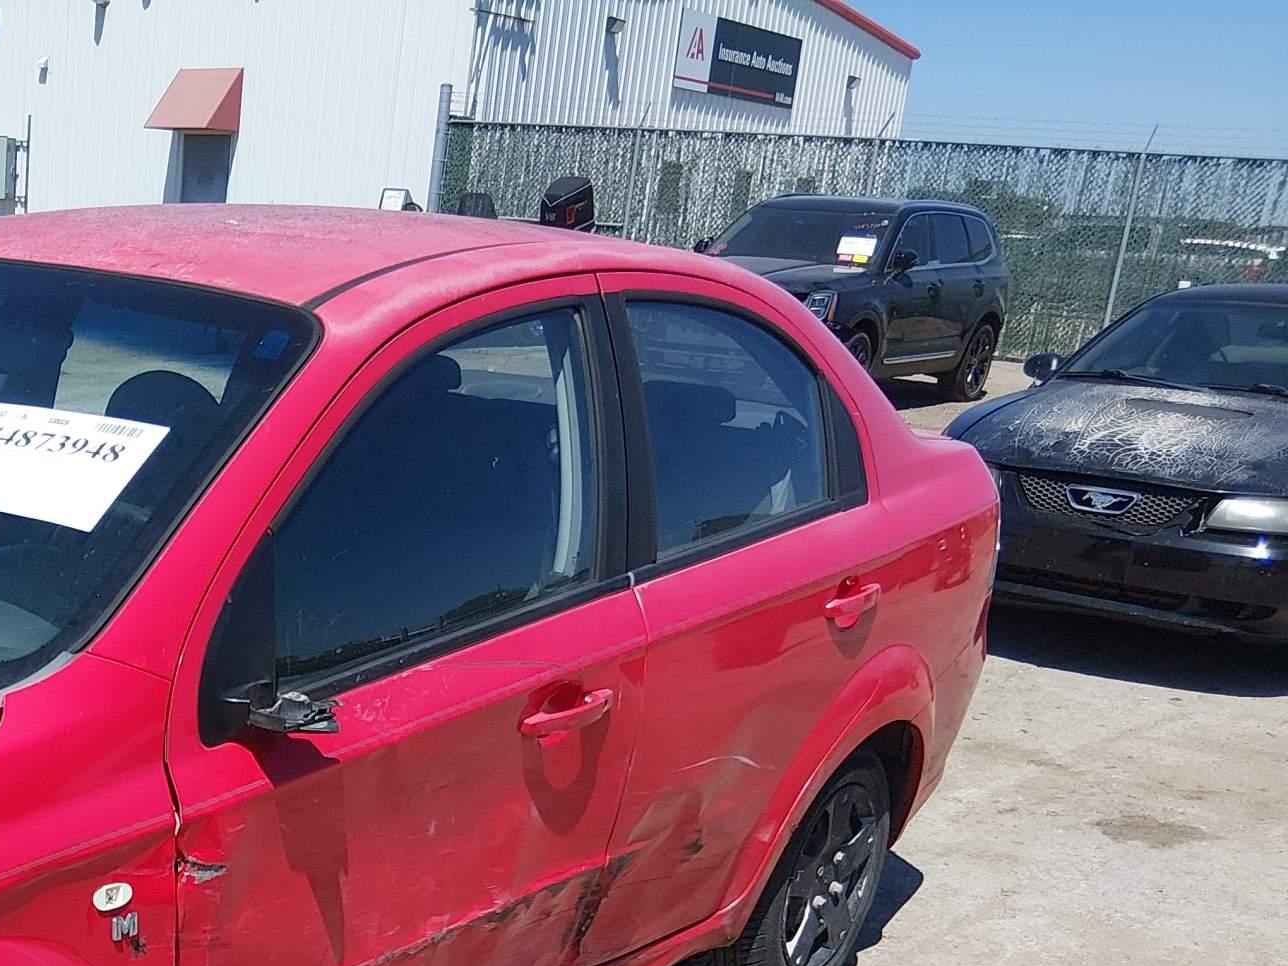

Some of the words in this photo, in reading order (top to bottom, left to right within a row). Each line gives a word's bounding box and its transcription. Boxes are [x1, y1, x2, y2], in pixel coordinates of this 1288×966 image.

[718, 42, 751, 67] Insurance
[750, 50, 766, 70] Auto
[766, 54, 793, 77] Auctions
